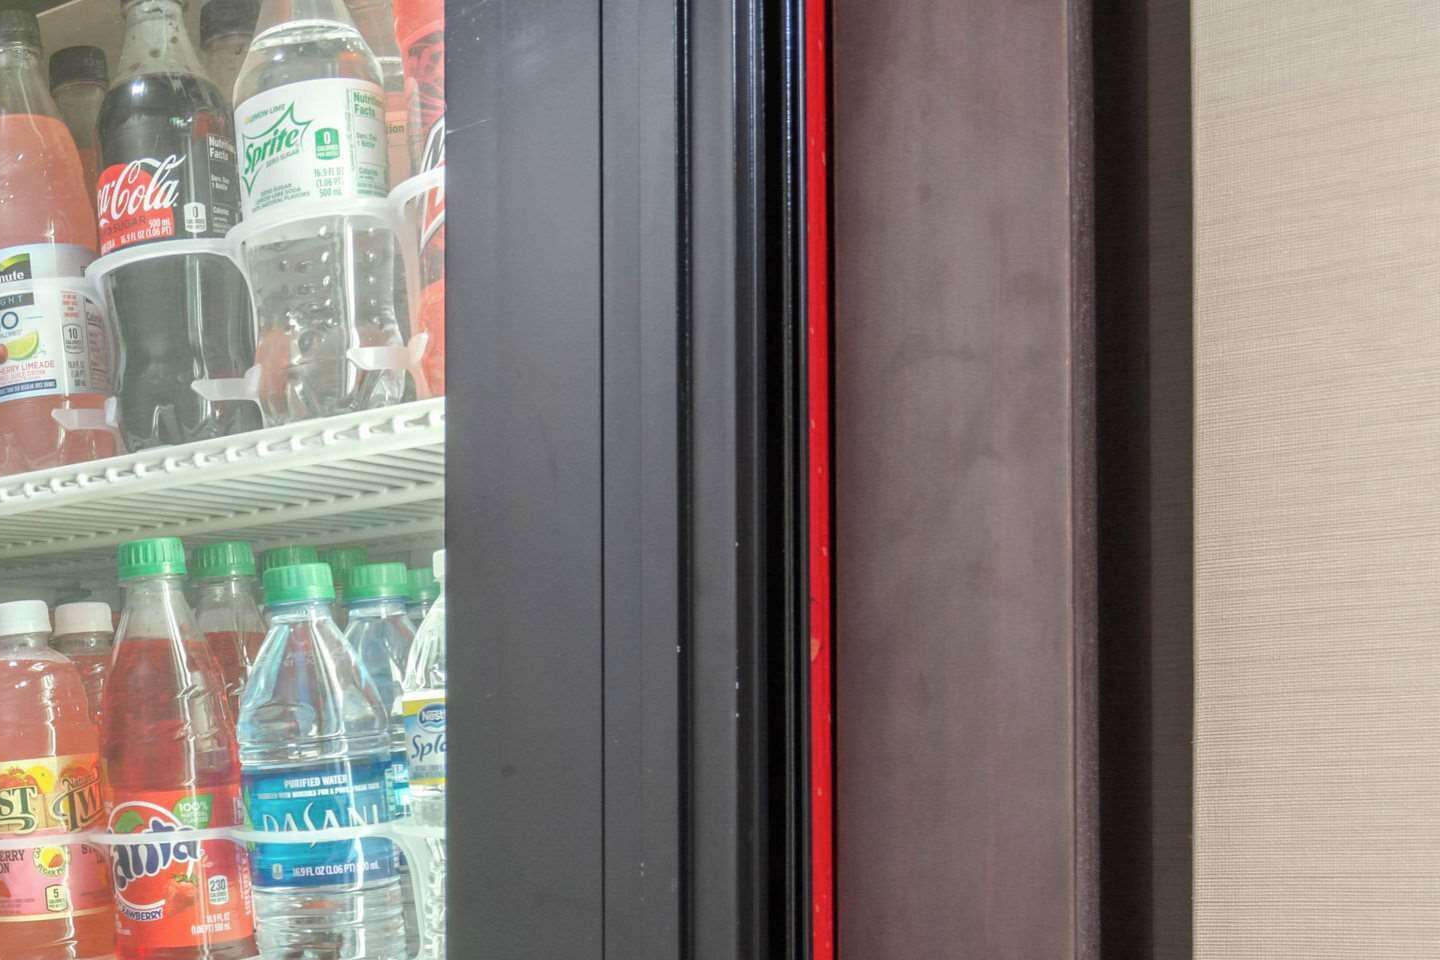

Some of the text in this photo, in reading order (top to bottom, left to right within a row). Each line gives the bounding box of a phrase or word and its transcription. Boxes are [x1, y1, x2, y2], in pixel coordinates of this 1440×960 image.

[244, 128, 300, 175] Sprite
[67, 328, 78, 339] 10
[21, 360, 55, 371] LIMEADE
[322, 774, 348, 786] WATER
